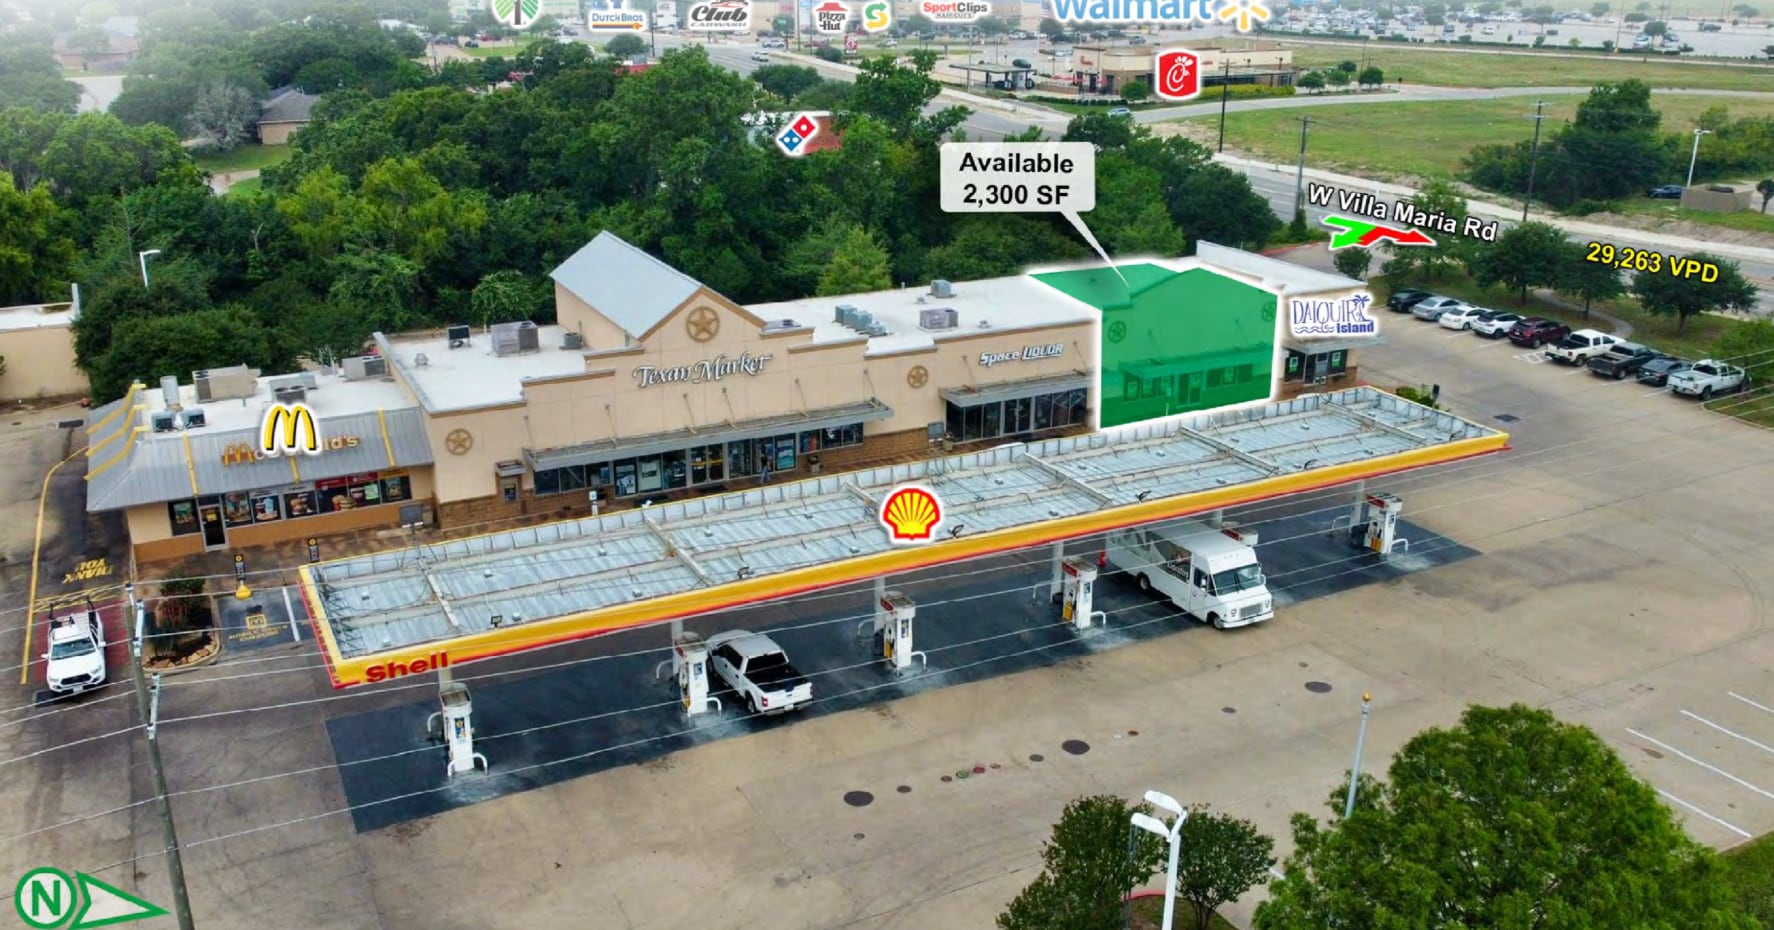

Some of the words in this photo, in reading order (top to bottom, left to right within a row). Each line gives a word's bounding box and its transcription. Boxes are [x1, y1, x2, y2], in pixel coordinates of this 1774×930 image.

[632, 364, 692, 388] Texan
[692, 350, 773, 384] Market
[978, 351, 1020, 367] Space
[366, 650, 448, 684] Shell
